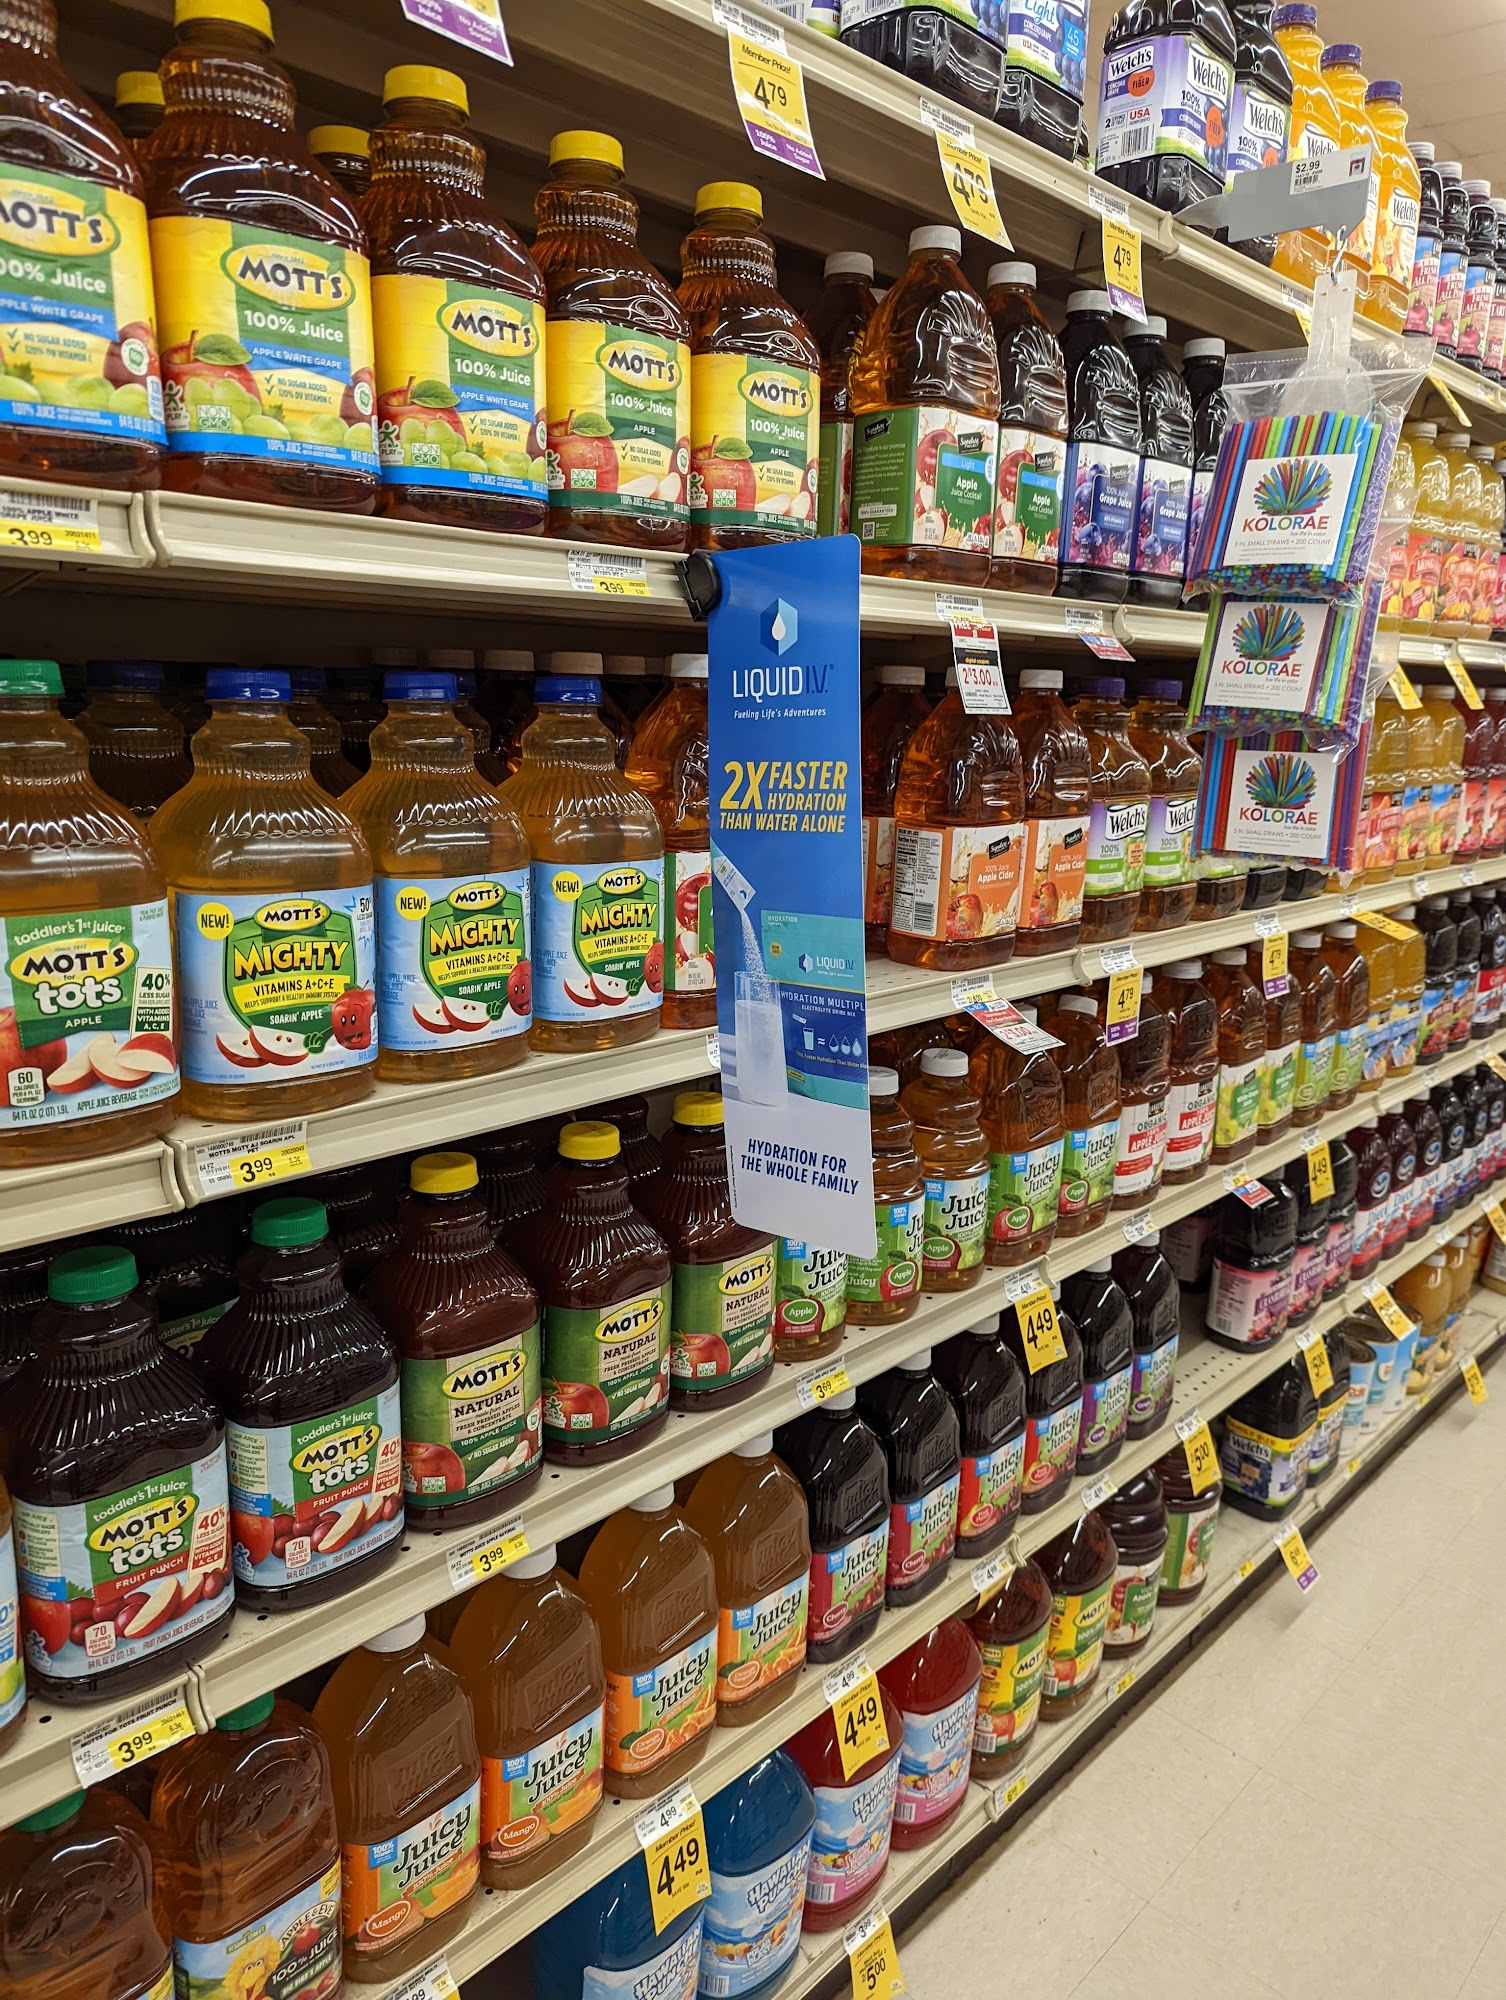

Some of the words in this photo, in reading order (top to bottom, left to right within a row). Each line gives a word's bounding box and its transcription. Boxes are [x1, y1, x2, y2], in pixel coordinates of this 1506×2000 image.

[418, 4, 444, 22] Juice
[742, 44, 770, 64] Member
[772, 60, 791, 74] Price!
[1111, 48, 1152, 76] Welch's
[1132, 76, 1150, 89] FIBER
[1191, 54, 1227, 96] Welch's
[1130, 110, 1150, 120] USA
[1249, 103, 1284, 136] Welch's
[755, 129, 776, 143] 100%
[1238, 136, 1257, 150] 100%
[760, 141, 777, 152] Juice
[786, 143, 795, 152] No
[796, 146, 813, 160] Added
[1296, 160, 1320, 173] $2.99
[1394, 203, 1417, 223] Welch's
[31, 303, 66, 316] WHITE
[70, 310, 104, 323] GRAPE
[243, 310, 295, 334] 100%
[300, 321, 343, 343] Juice
[252, 347, 281, 359] APPLE
[283, 350, 312, 364] WHITE
[315, 357, 341, 369] GRAPE
[455, 358, 495, 379] 100%
[500, 368, 531, 386] Juice
[277, 378, 287, 386] NO
[288, 380, 307, 389] SUGAR
[309, 384, 327, 392] ADDED
[461, 391, 483, 401] APPLE
[486, 395, 508, 407] WHITE
[509, 400, 529, 410] GRAPE
[199, 405, 229, 418] NON
[199, 418, 230, 429] GMO
[634, 424, 655, 435] APPLE
[750, 419, 779, 434] 100%
[781, 428, 805, 441] Juice
[412, 444, 439, 453] NON
[770, 448, 789, 458] APPLE
[572, 469, 595, 479] NON
[962, 460, 975, 470] Light
[957, 476, 977, 490] Apple
[713, 489, 735, 498] NON
[1033, 493, 1050, 505] Apple
[1100, 493, 1116, 507] Grape
[1118, 497, 1131, 509] Juice
[27, 508, 52, 516] APPLE
[55, 511, 79, 519] WHITE
[1242, 516, 1329, 532] KOLORAE
[1222, 660, 1301, 677] KOLORAE
[732, 665, 803, 703] LIQUID
[734, 710, 759, 720] Fueling
[762, 709, 781, 719] Life's
[784, 708, 826, 717] Adventures
[720, 761, 768, 810] 2X
[768, 762, 848, 790] FASTER
[767, 793, 846, 811] HYDRATION
[720, 813, 751, 829] THAN
[756, 813, 797, 831] WATER
[801, 815, 845, 833] ALONE
[1109, 808, 1145, 833] Welch's
[1239, 807, 1318, 825] KOLORAE
[1101, 844, 1120, 854] 100%
[1055, 863, 1070, 872] Apple
[1072, 860, 1085, 869] Cider
[556, 881, 579, 893] NEW!
[977, 873, 997, 883] Apple
[999, 871, 1014, 880] Cider
[400, 896, 426, 910] NEW!
[201, 914, 229, 929] NEW!
[581, 903, 657, 935] MIGHTY
[429, 919, 520, 956] MIGHTY
[234, 941, 348, 980] MIGHTY
[34, 976, 122, 1015] tots
[65, 1016, 102, 1029] APPLE
[18, 1071, 33, 1084] 60
[77, 1100, 95, 1112] APPLE
[96, 1097, 111, 1108] JUICE
[111, 1091, 138, 1105] BEVERAGE
[748, 1139, 817, 1167] HYDRATION
[821, 1154, 847, 1174] FOR
[1024, 1150, 1060, 1183] Juicy
[741, 1155, 761, 1173] THE
[766, 1161, 807, 1183] WHOLE
[812, 1171, 858, 1195] FAMILY
[1010, 1211, 1027, 1223] Apple
[926, 1244, 949, 1252] Apple
[726, 1286, 769, 1312] NATURAL
[789, 1307, 813, 1317] Apple
[603, 1333, 656, 1360] NATURAL
[455, 1386, 520, 1418] NATURAL
[1232, 1437, 1270, 1458] Welch's
[309, 1454, 369, 1494] tots
[988, 1446, 1023, 1484] Juicy
[313, 1495, 339, 1508] FRUIT
[341, 1481, 369, 1497] PUNCH
[920, 1487, 957, 1528] Juicy
[921, 1507, 952, 1540] Juice
[109, 1528, 185, 1575] tots
[905, 1553, 924, 1568] Cherry
[116, 1572, 146, 1589] FRUIT
[150, 1557, 184, 1577] PUNCH
[750, 1589, 802, 1634] Juicy
[93, 1626, 106, 1636] 70
[752, 1612, 796, 1650] Juice
[636, 1674, 653, 1684] 100%
[652, 1648, 710, 1701] Juicy
[656, 1674, 704, 1716] Juice
[81, 1734, 103, 1748] MOTTS
[105, 1727, 118, 1736] FOR
[119, 1719, 135, 1729] TOTS
[136, 1709, 154, 1722] FRUIT
[156, 1699, 176, 1712] PUNCH
[932, 1694, 979, 1743] HAWAIIAN
[392, 1804, 471, 1874] Juicy
[503, 1822, 535, 1840] Mango
[655, 1830, 681, 1852] Member
[680, 1820, 696, 1836] Price!
[399, 1835, 463, 1889] Juice
[748, 1841, 810, 1905] HAWAIIAN
[281, 1914, 311, 1949] APPLE
[318, 1904, 333, 1915] EVE
[372, 1907, 406, 1930] Mango
[272, 1956, 307, 1985] 100%
[309, 1928, 337, 1958] JUICE
[282, 1983, 293, 1996] BIG
[295, 1969, 314, 1987] BIRD'S
[314, 1955, 331, 1972] APPLE
